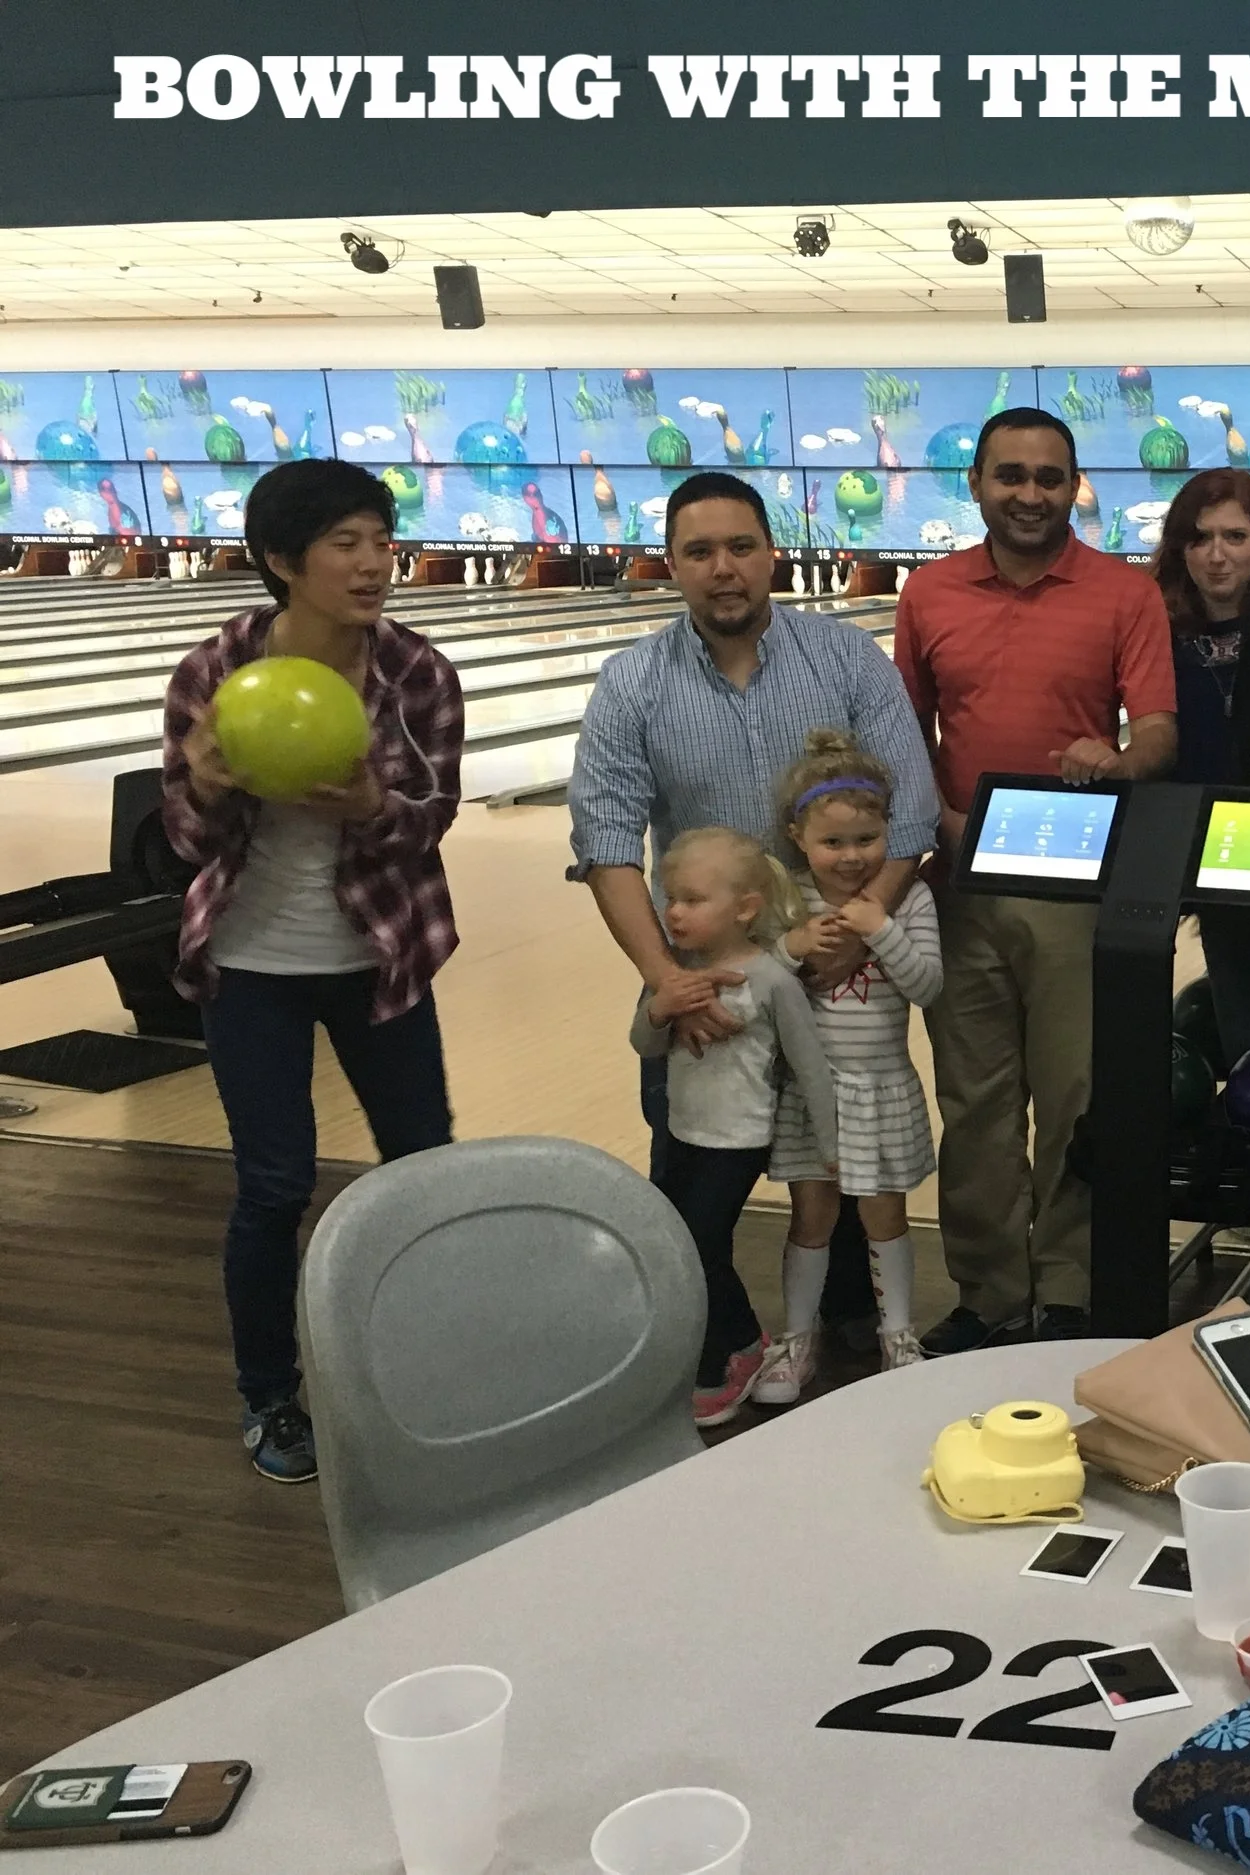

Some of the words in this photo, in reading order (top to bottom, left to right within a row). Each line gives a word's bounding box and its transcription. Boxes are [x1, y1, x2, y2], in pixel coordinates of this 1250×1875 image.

[134, 536, 143, 547] 8
[160, 537, 169, 547] 9
[423, 543, 455, 551] COLONIAL
[456, 544, 487, 552] BOWLING
[558, 544, 572, 555] 12
[586, 545, 600, 556] 13
[645, 547, 666, 555] COLO
[787, 549, 802, 560] 14
[816, 550, 831, 561] 15
[879, 552, 915, 560] COLONIAL
[815, 1629, 1117, 1751] 22
